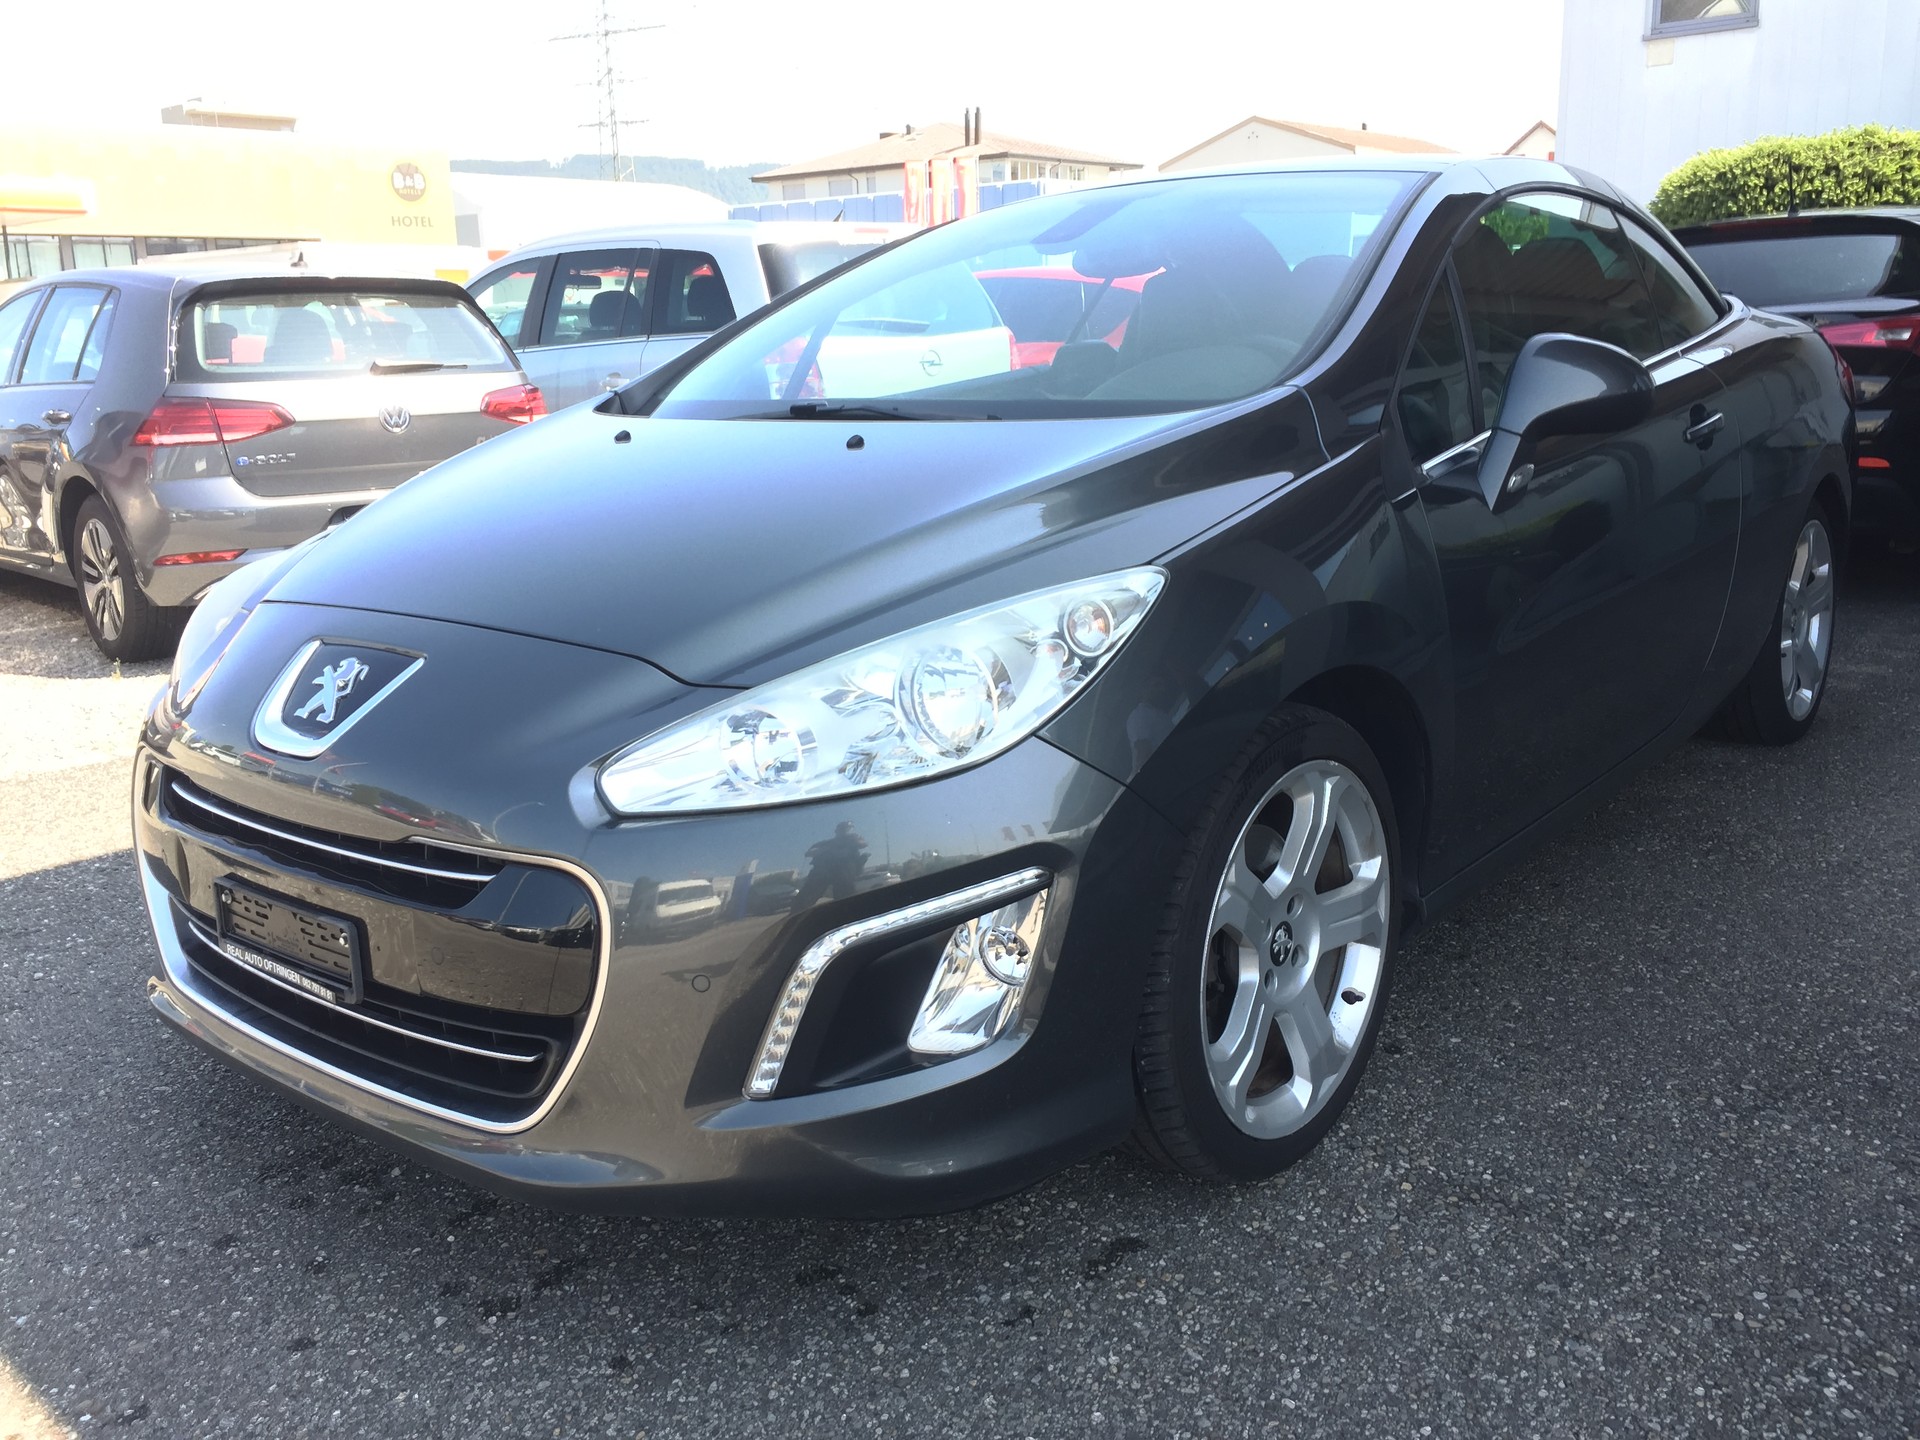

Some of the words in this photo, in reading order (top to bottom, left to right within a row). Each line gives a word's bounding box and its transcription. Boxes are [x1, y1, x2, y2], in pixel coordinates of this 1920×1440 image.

[393, 171, 425, 190] B&B
[391, 215, 434, 228] HOTEL
[226, 944, 244, 960] REAL
[244, 951, 263, 968] AUTO
[264, 959, 301, 985] OFTRINGEN
